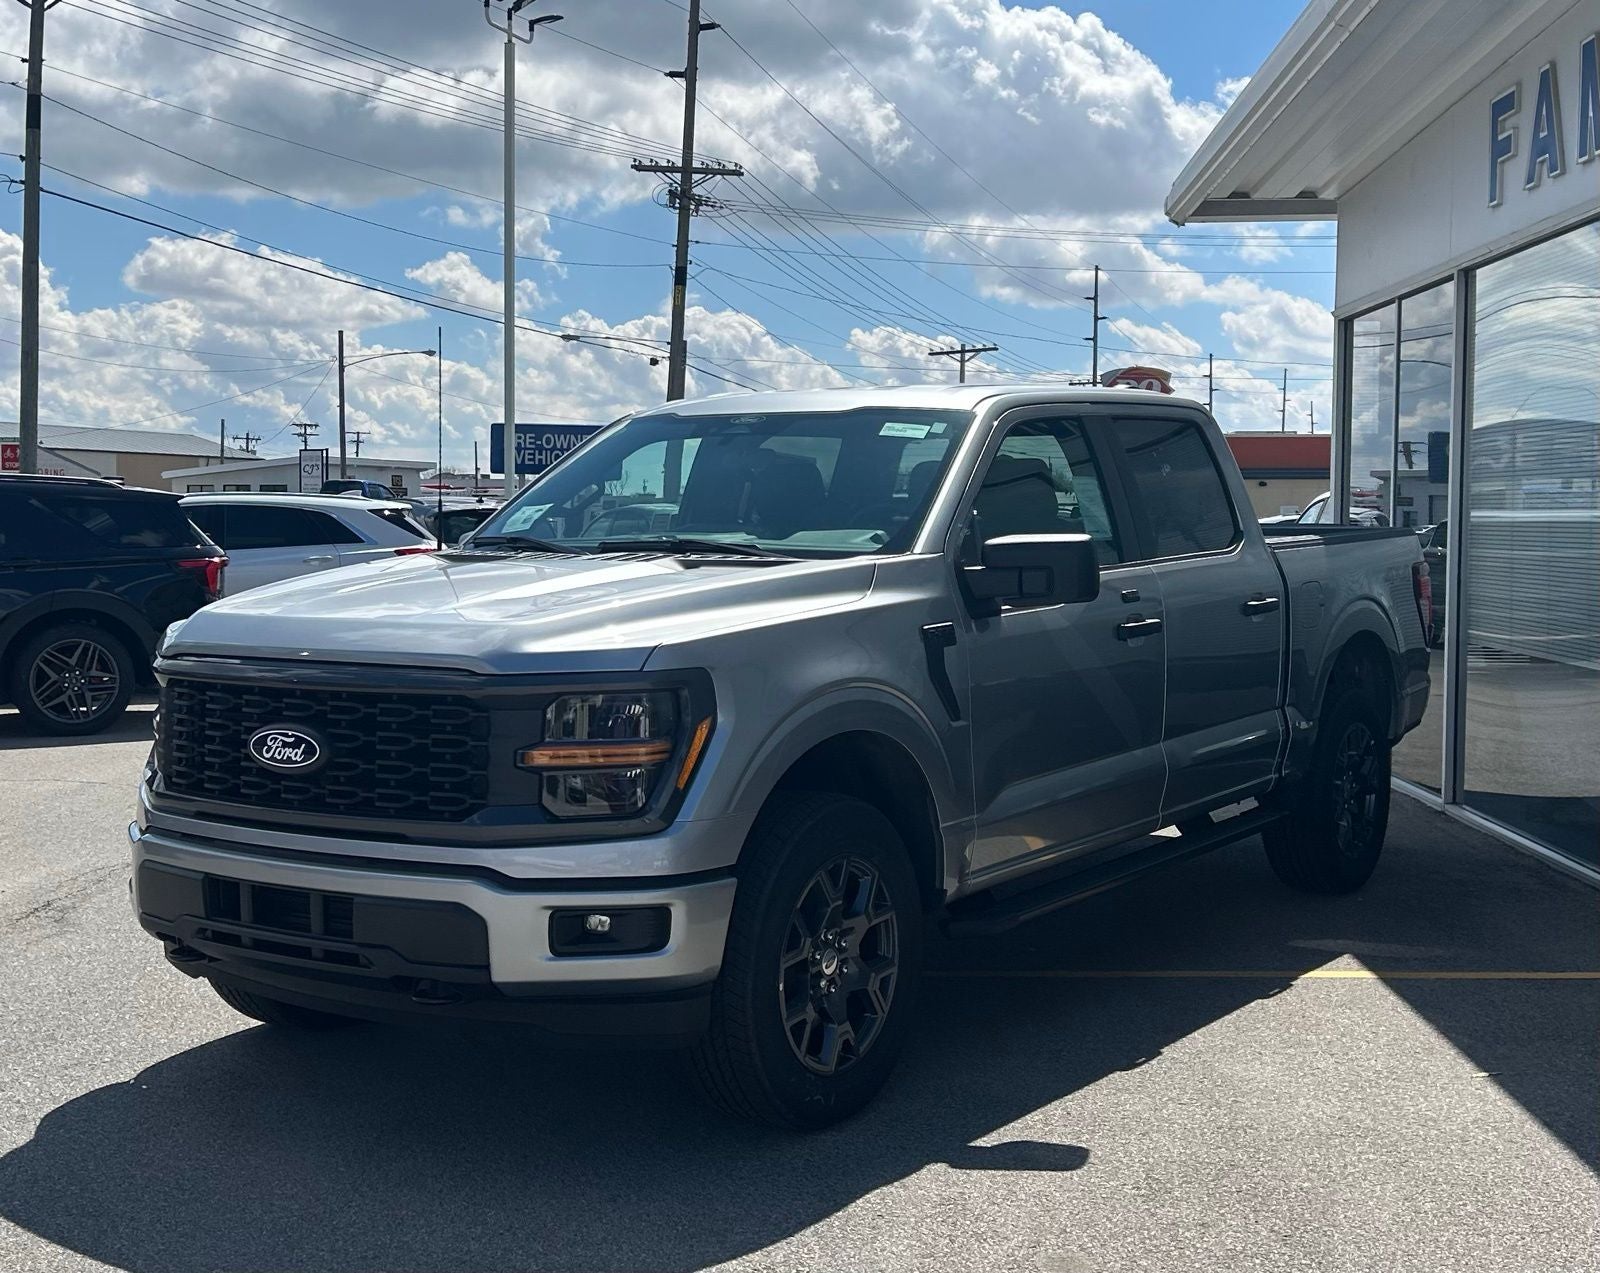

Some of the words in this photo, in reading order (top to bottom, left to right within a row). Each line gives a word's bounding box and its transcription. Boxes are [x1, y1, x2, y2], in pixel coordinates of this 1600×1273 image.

[515, 433, 594, 449] RE-OWN
[515, 450, 566, 466] VEHIC
[262, 734, 306, 762] Ford
